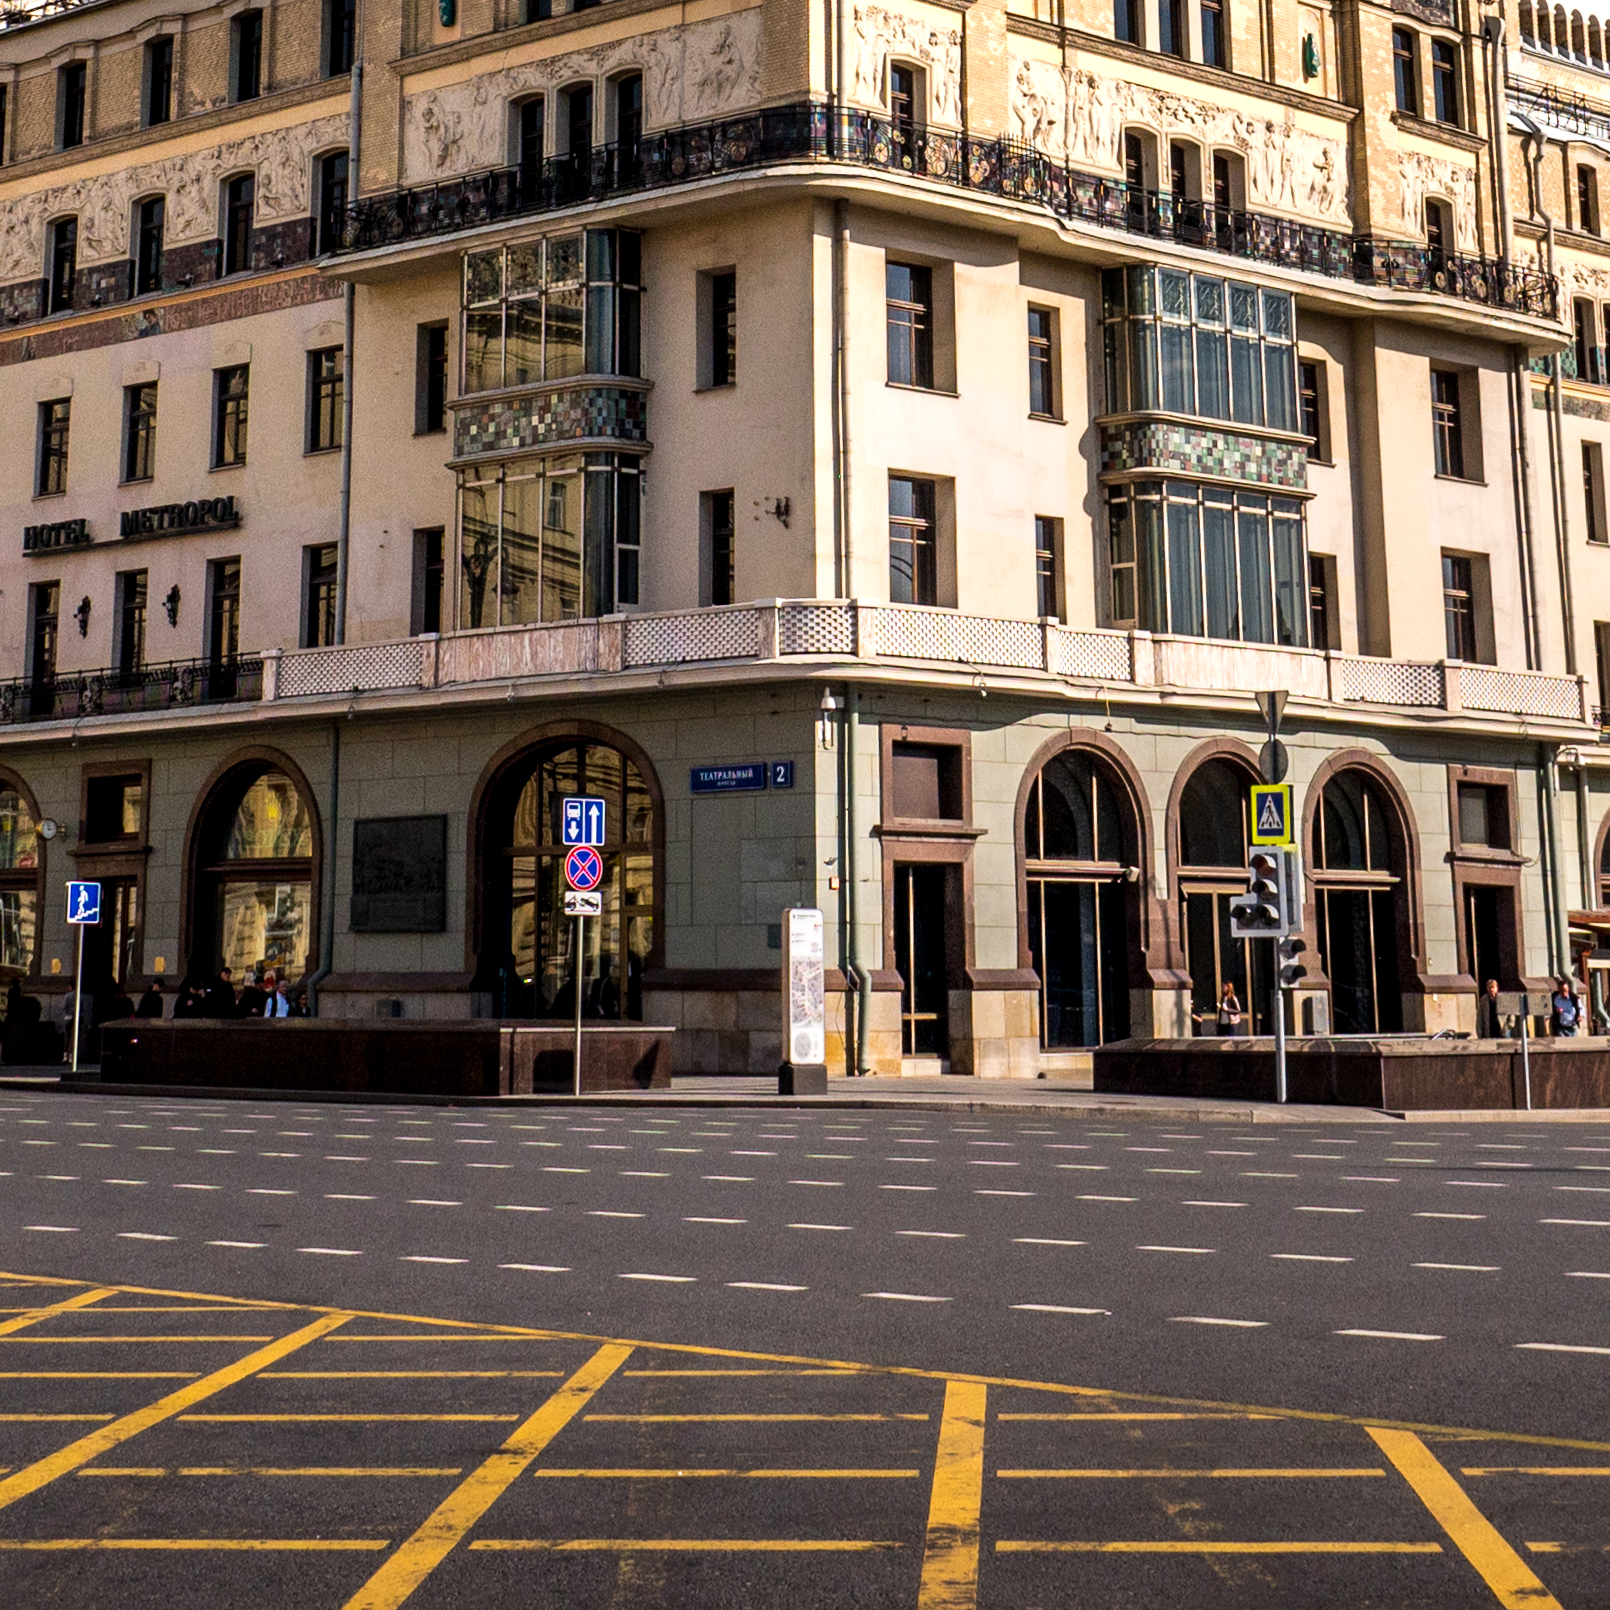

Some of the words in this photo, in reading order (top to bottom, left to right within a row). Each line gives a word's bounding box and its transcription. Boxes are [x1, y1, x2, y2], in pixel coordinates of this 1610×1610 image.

[23, 518, 91, 550] HOTEL
[120, 496, 240, 537] METROPOL
[700, 768, 754, 781] ТЕАТРАЛЬНЫЙ
[776, 765, 785, 783] 2
